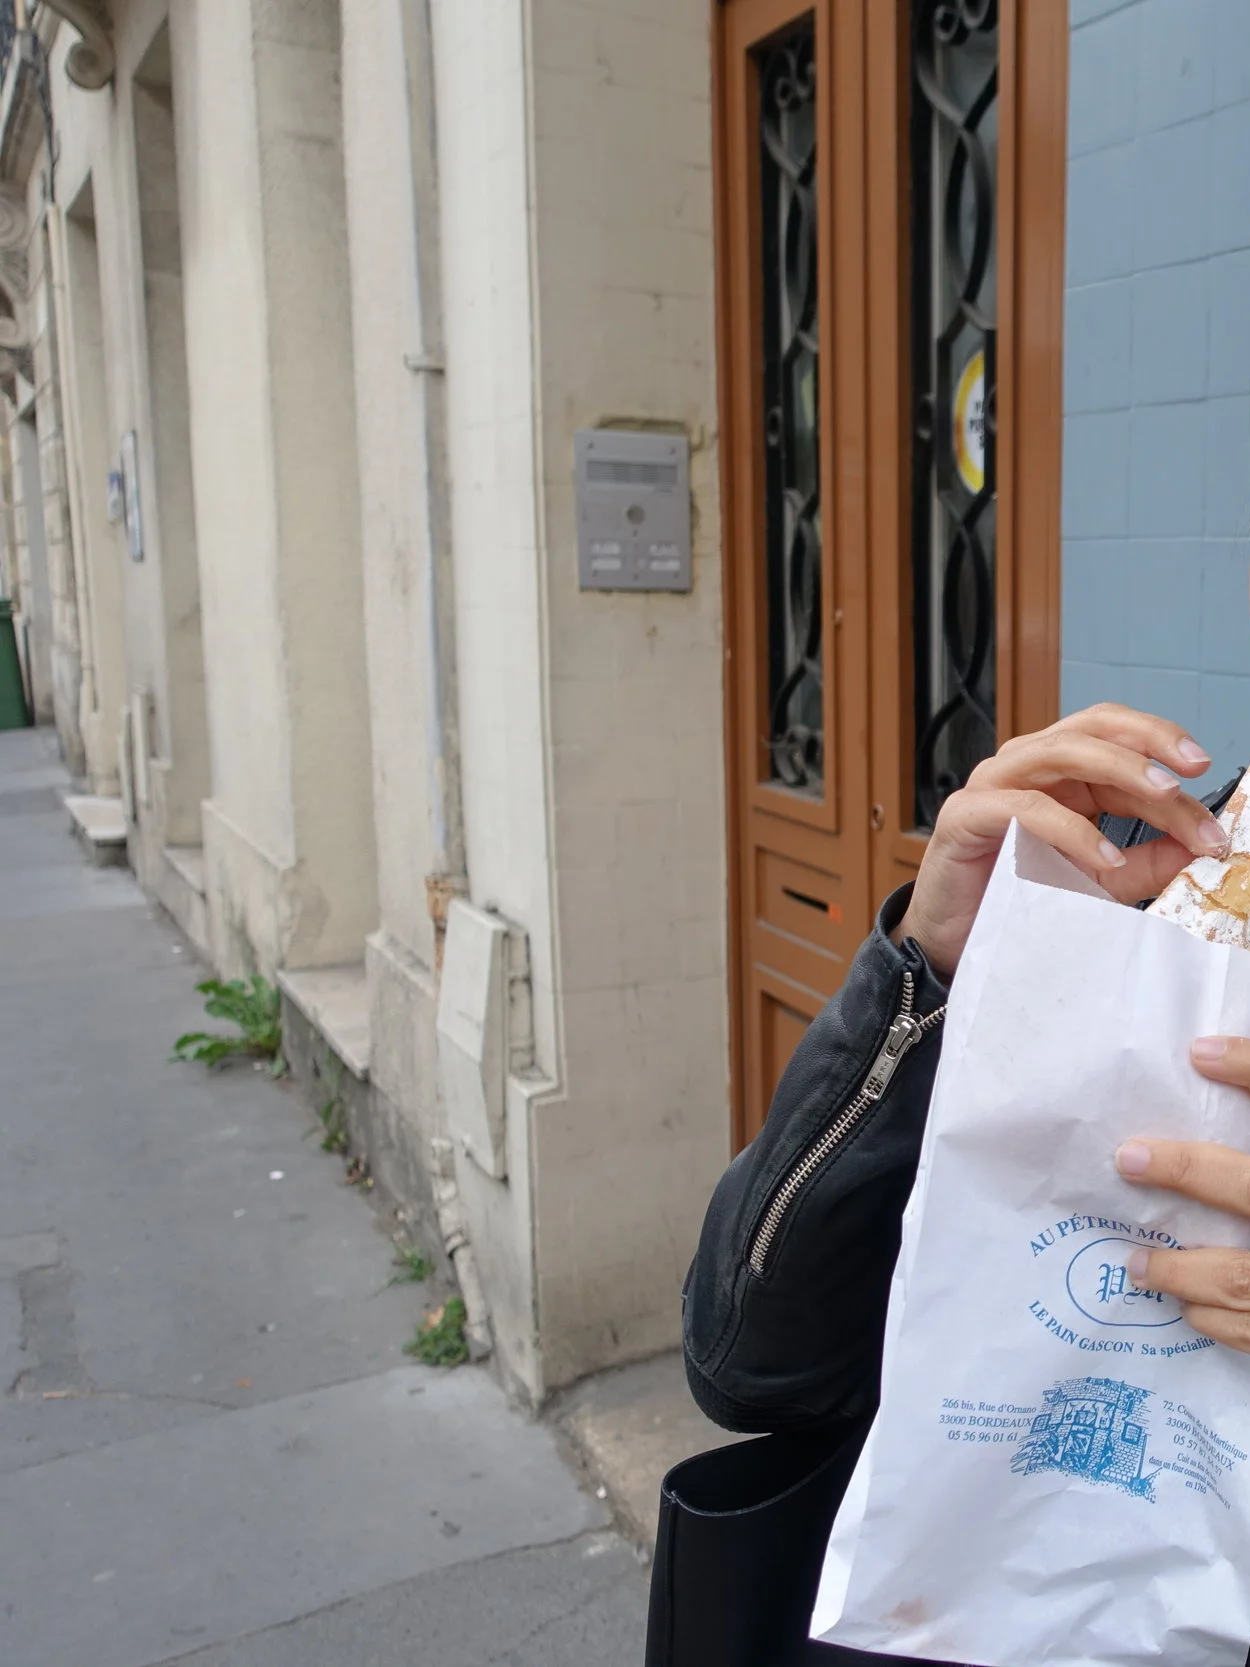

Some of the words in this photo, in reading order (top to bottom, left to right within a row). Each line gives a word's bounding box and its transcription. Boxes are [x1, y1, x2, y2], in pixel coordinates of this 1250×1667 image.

[1028, 1228, 1056, 1257] AU
[1056, 1212, 1133, 1238] PÉTRIN
[1028, 1299, 1050, 1322] LE
[1044, 1316, 1079, 1346] PAIN
[1078, 1337, 1135, 1354] GASCON
[1140, 1343, 1157, 1356] Sa
[941, 1398, 960, 1409] 266
[960, 1399, 976, 1411] bis,
[978, 1401, 996, 1412] Rue
[938, 1414, 967, 1425] 33000
[967, 1415, 1034, 1429] BORDEAUX
[1165, 1416, 1191, 1433] 33000
[947, 1429, 962, 1441] 05
[962, 1430, 977, 1441] 56
[977, 1431, 991, 1443] 96
[992, 1432, 1005, 1443] 01
[1006, 1432, 1019, 1442] 61
[1162, 1400, 1175, 1413] 72,
[1208, 1430, 1248, 1461] Martinique
[1173, 1433, 1186, 1446] 05
[1186, 1439, 1198, 1451] 57
[1148, 1456, 1163, 1466] dans
[1171, 1462, 1184, 1474] four
[1185, 1480, 1193, 1489] en
